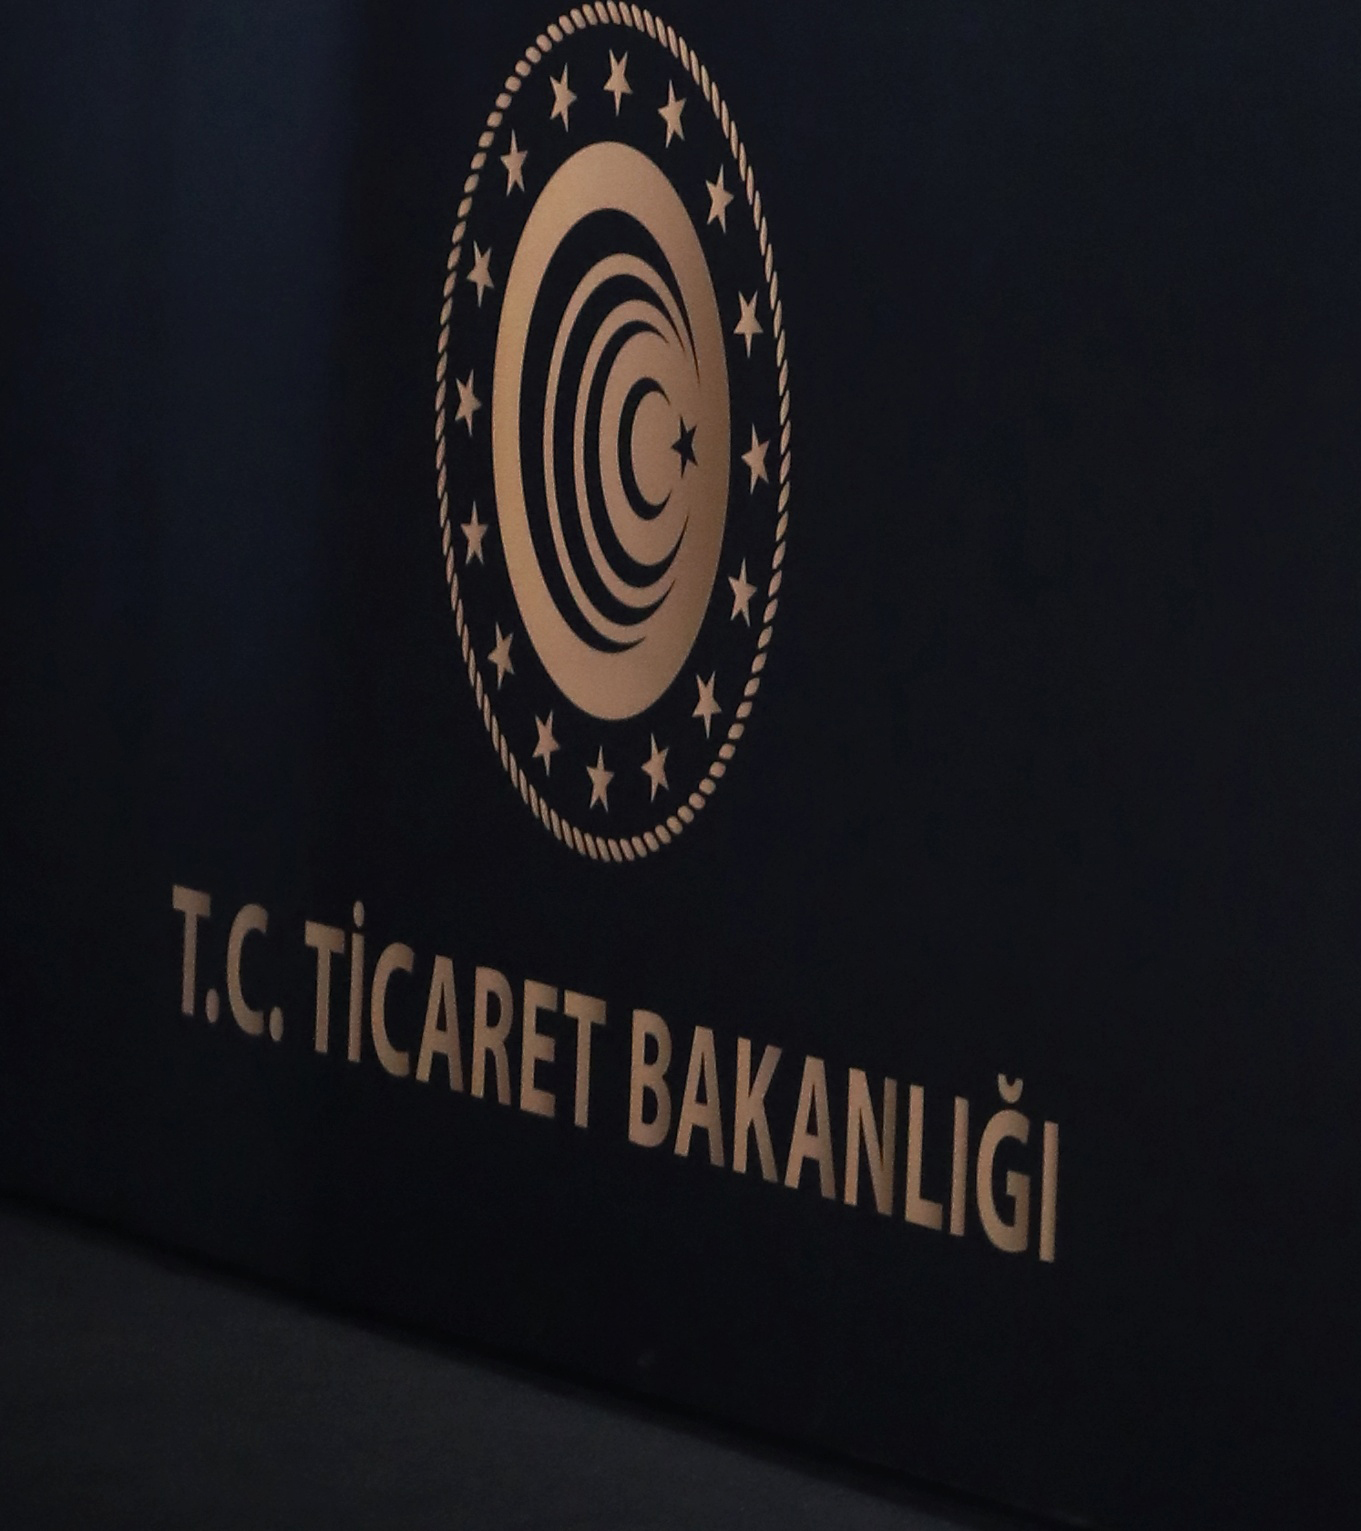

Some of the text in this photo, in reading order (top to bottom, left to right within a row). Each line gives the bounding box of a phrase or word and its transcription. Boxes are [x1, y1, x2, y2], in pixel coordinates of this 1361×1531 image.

[172, 883, 1059, 1263] T.C. TİCARET BAKANLIĞI
